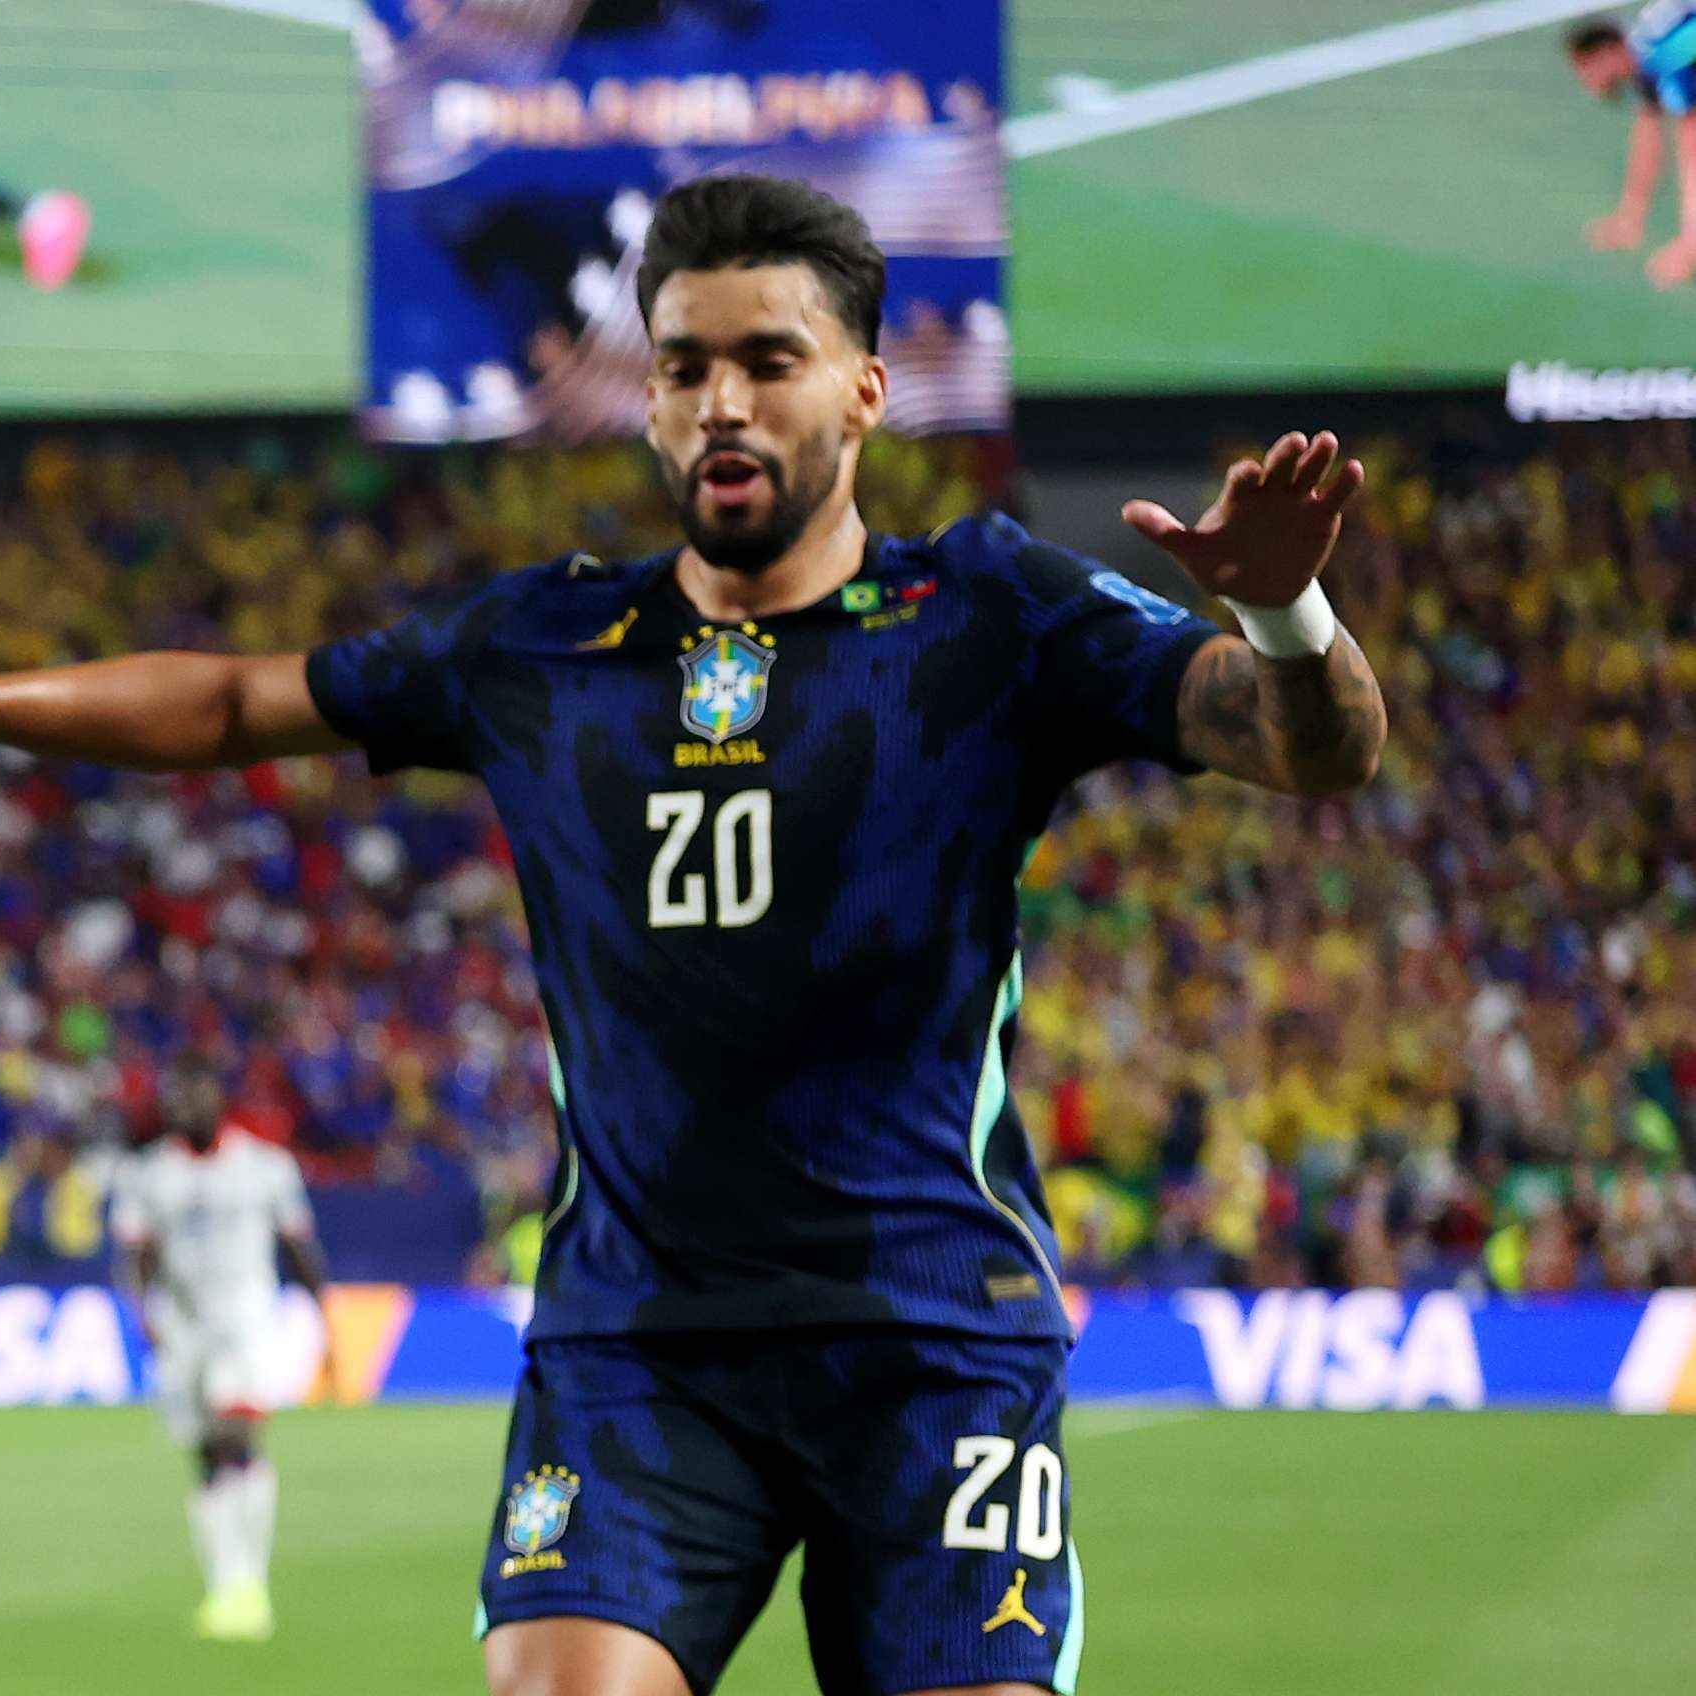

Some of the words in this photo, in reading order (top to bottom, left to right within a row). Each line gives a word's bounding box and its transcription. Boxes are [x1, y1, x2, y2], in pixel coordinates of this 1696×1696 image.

[674, 740, 766, 767] BRASIL
[646, 789, 773, 928] 20
[1179, 1288, 1487, 1411] VISA
[942, 1435, 1063, 1560] 20
